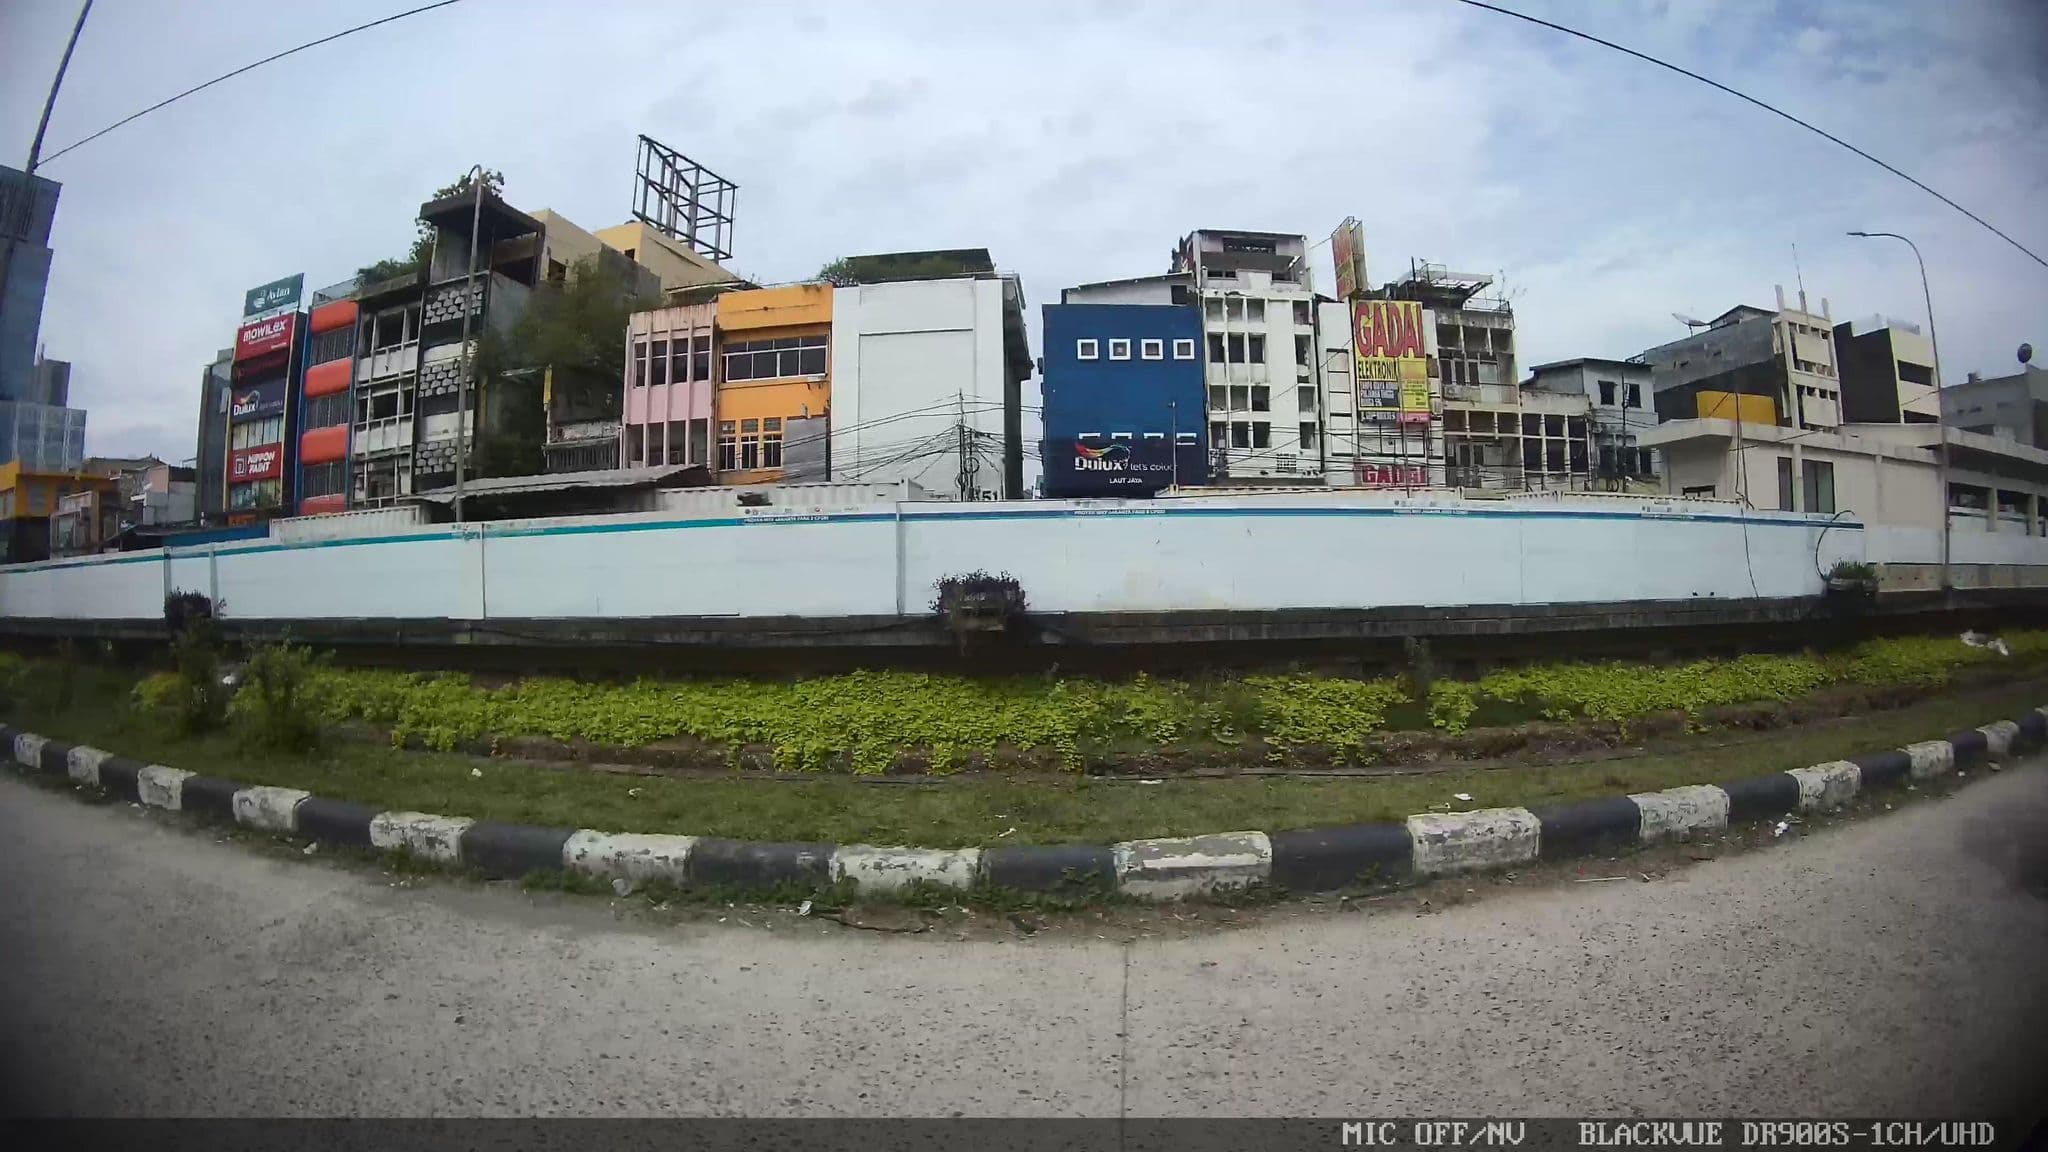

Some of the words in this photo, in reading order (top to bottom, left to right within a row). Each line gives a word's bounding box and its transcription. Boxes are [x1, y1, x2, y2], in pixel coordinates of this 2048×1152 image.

[1354, 300, 1426, 359] GADAI
[233, 403, 256, 416] Dulux
[247, 450, 275, 465] NIPPON
[1075, 456, 1123, 471] Dulux
[248, 461, 271, 474] PAINT
[1109, 477, 1127, 485] LAUT
[1127, 477, 1143, 485] JAYA
